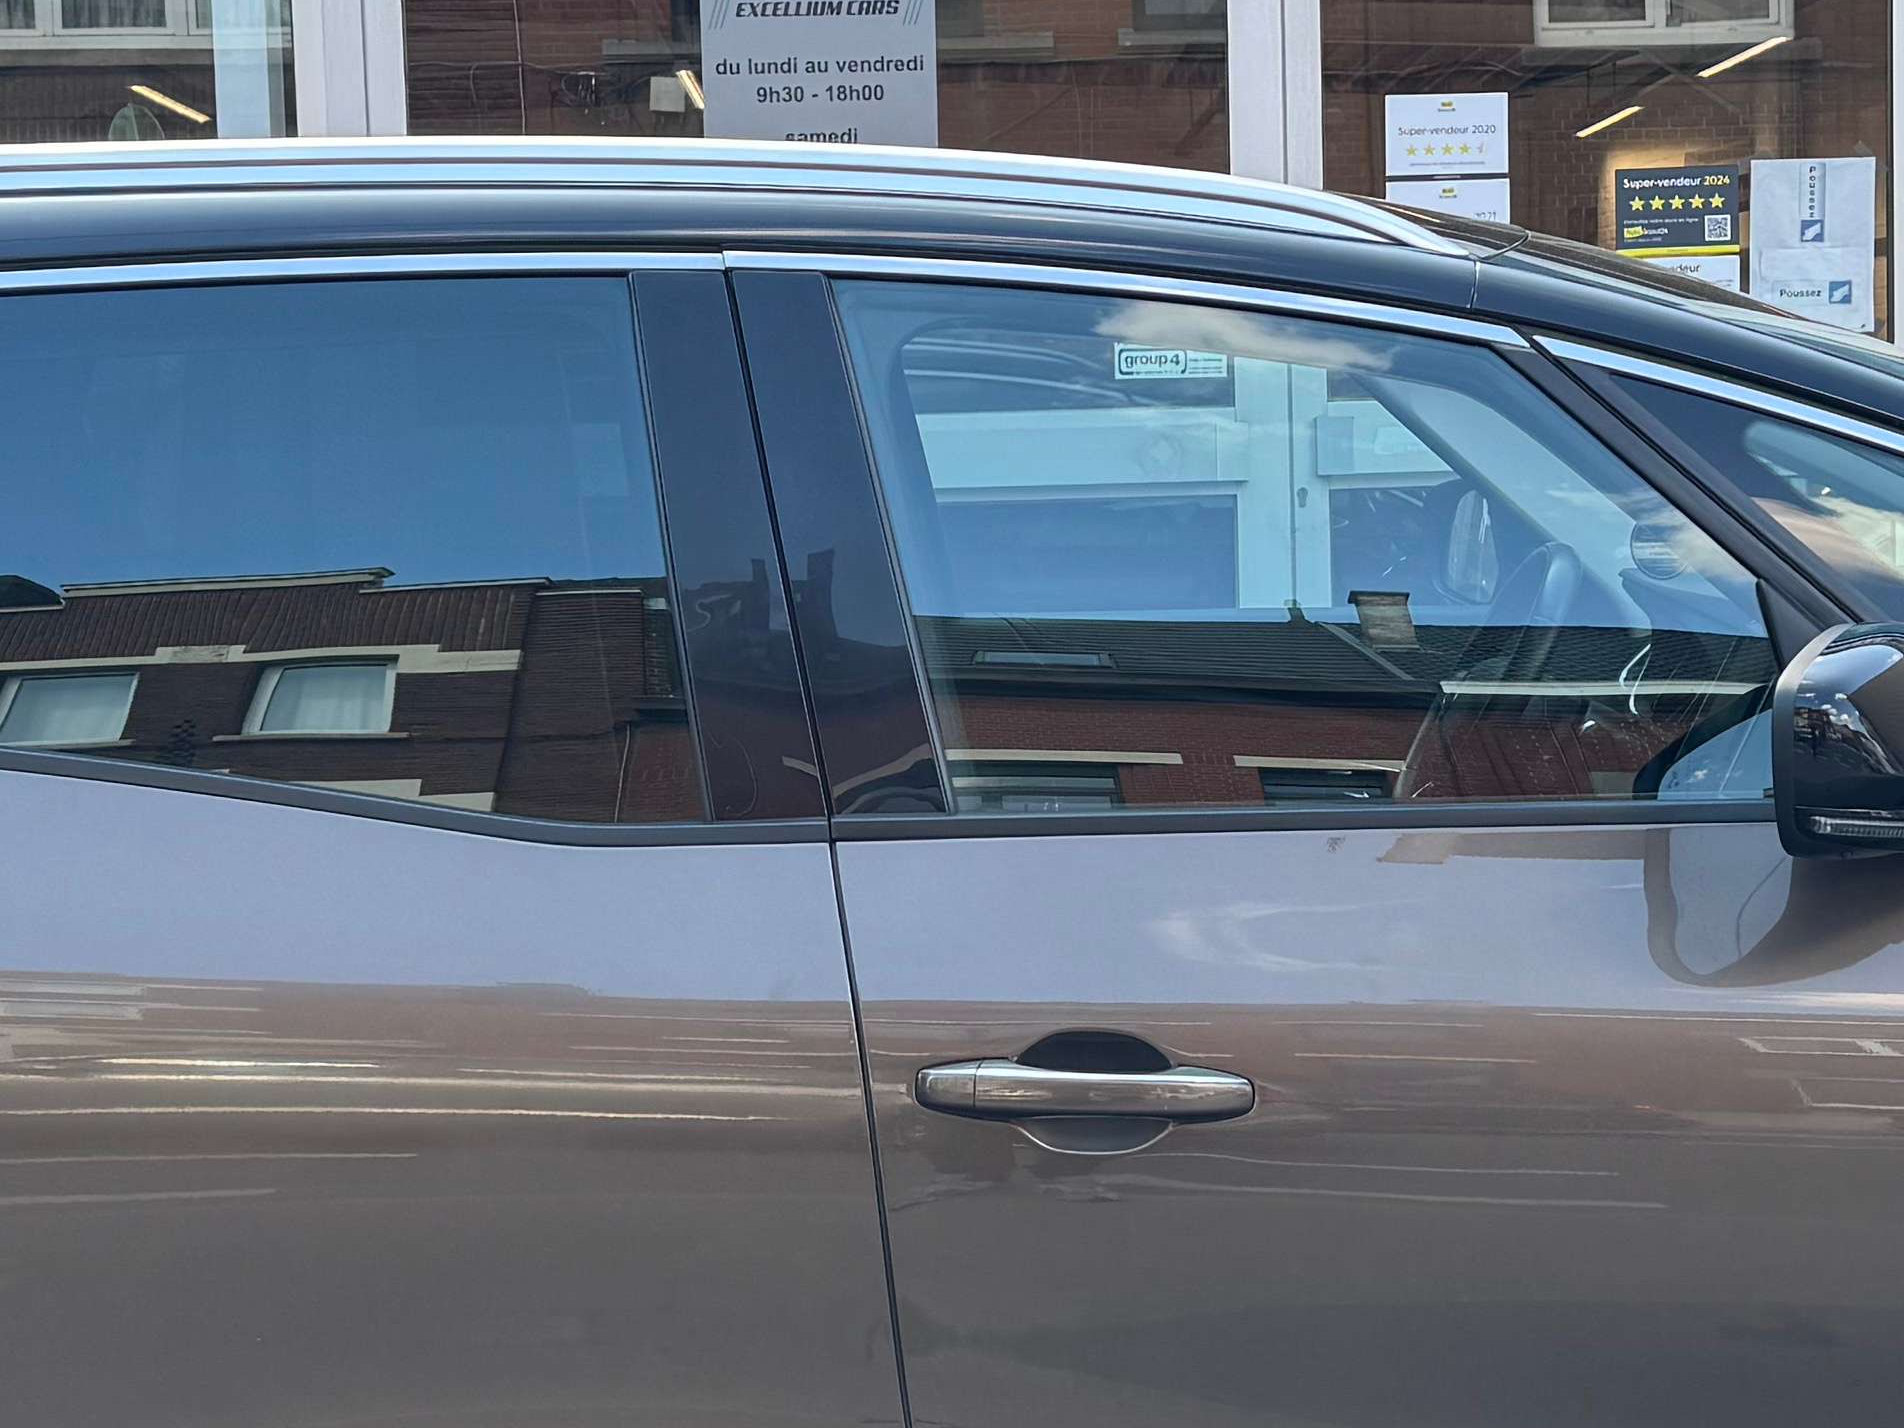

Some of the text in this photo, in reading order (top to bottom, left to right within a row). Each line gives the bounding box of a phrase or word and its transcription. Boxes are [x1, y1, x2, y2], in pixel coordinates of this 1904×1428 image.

[735, 0, 901, 18] EXCELLIUM CARS
[715, 54, 925, 75] du lundi au vendredi
[756, 86, 805, 104] 9h30
[825, 84, 885, 103] 18h00
[1471, 124, 1497, 135] 2020
[1623, 175, 1731, 190] Super-vendeur 2024
[1779, 288, 1822, 298] Poussez
